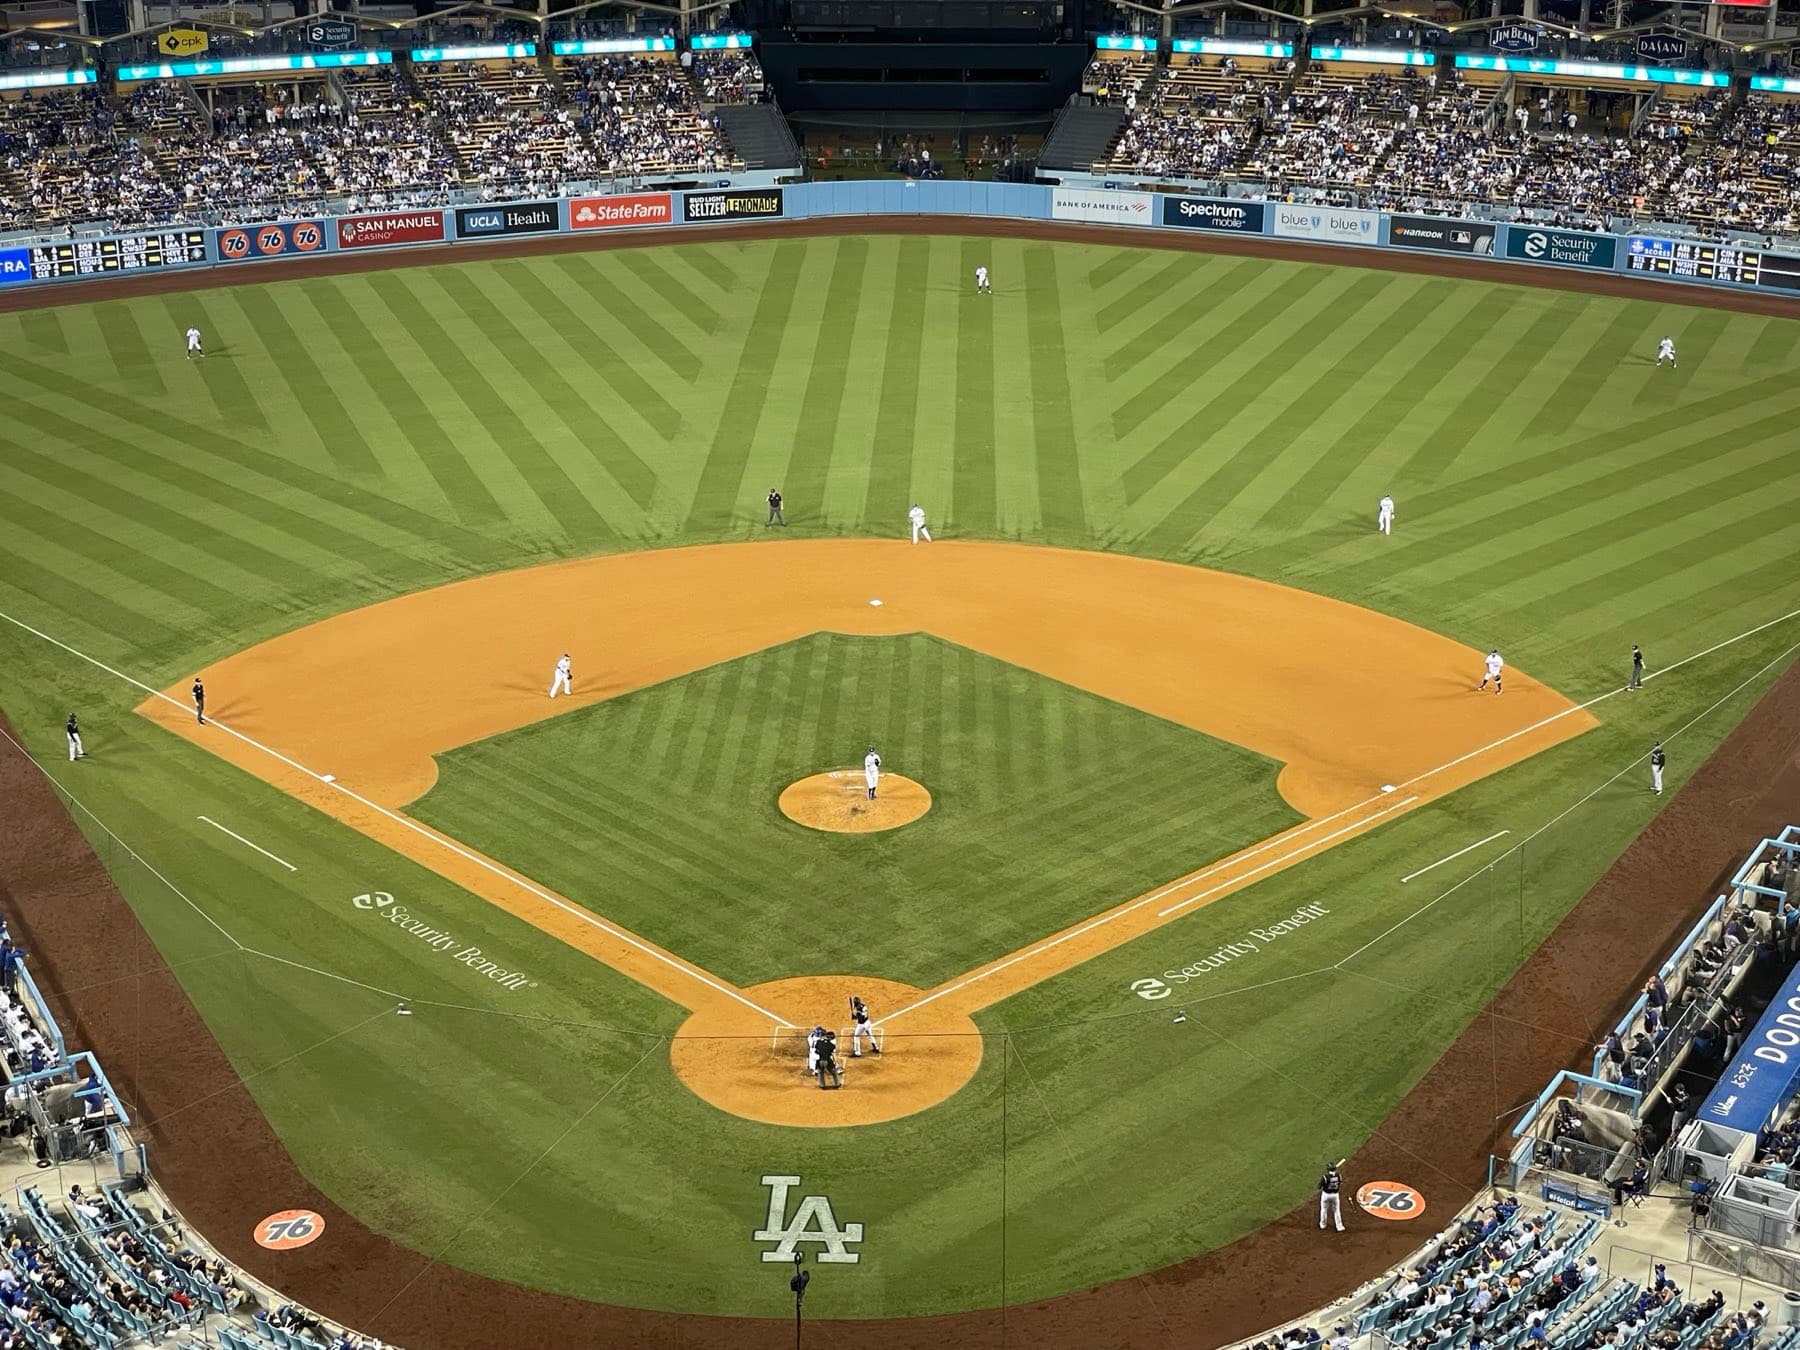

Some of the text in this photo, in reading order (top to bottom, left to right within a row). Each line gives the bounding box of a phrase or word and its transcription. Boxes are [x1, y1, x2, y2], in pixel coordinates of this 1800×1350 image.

[181, 36, 202, 48] cpk
[1492, 26, 1535, 47] JIM BEAM
[1641, 40, 1683, 54] DASANI
[689, 202, 727, 217] SELTZER
[727, 197, 778, 213] LEMONADE
[1057, 201, 1080, 209] BANK
[1093, 203, 1129, 212] AMERICA
[1180, 201, 1243, 218] Spectrum
[356, 216, 439, 233] SAN MANUEL
[469, 211, 550, 228] UCLA Health
[1211, 217, 1242, 228] mobile
[1281, 213, 1309, 226] blue
[1330, 217, 1358, 230] blue
[225, 232, 247, 253] 76
[262, 229, 283, 249] 76
[297, 226, 319, 245] 76
[357, 231, 391, 241] CASINO
[1551, 235, 1597, 252] Security
[1551, 247, 1590, 263] Benefit
[381, 905, 528, 990] Security Benefit
[1163, 905, 1330, 984] Security Benefit
[1364, 1189, 1416, 1212] 76
[754, 1175, 863, 1263] LA
[263, 1214, 317, 1243] 76
